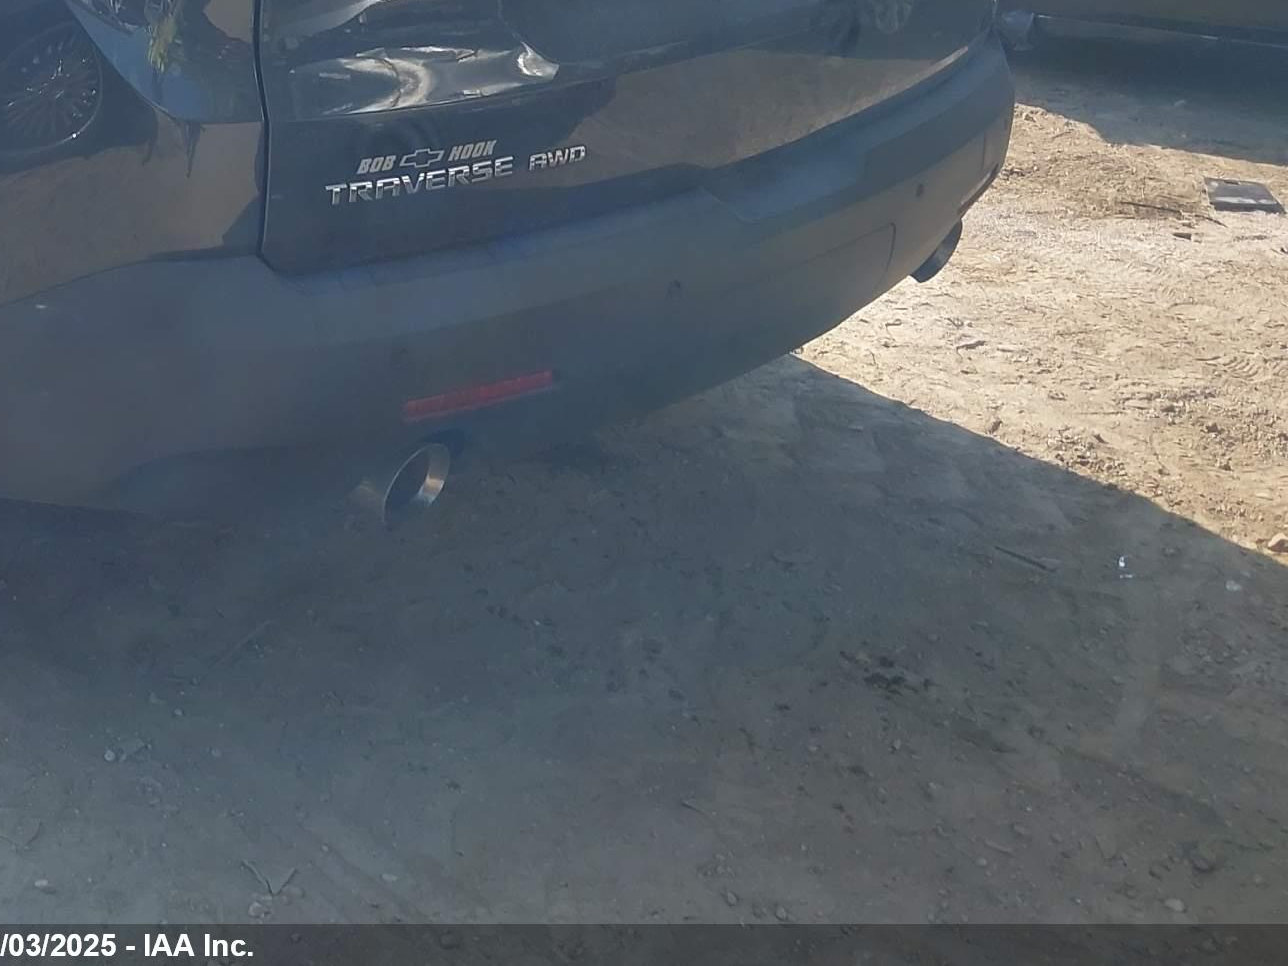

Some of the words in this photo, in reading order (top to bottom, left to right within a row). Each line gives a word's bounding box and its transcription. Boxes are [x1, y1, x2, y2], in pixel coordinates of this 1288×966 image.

[325, 156, 514, 206] TRAVERSE
[528, 145, 586, 171] AWD
[357, 154, 397, 175] BOB
